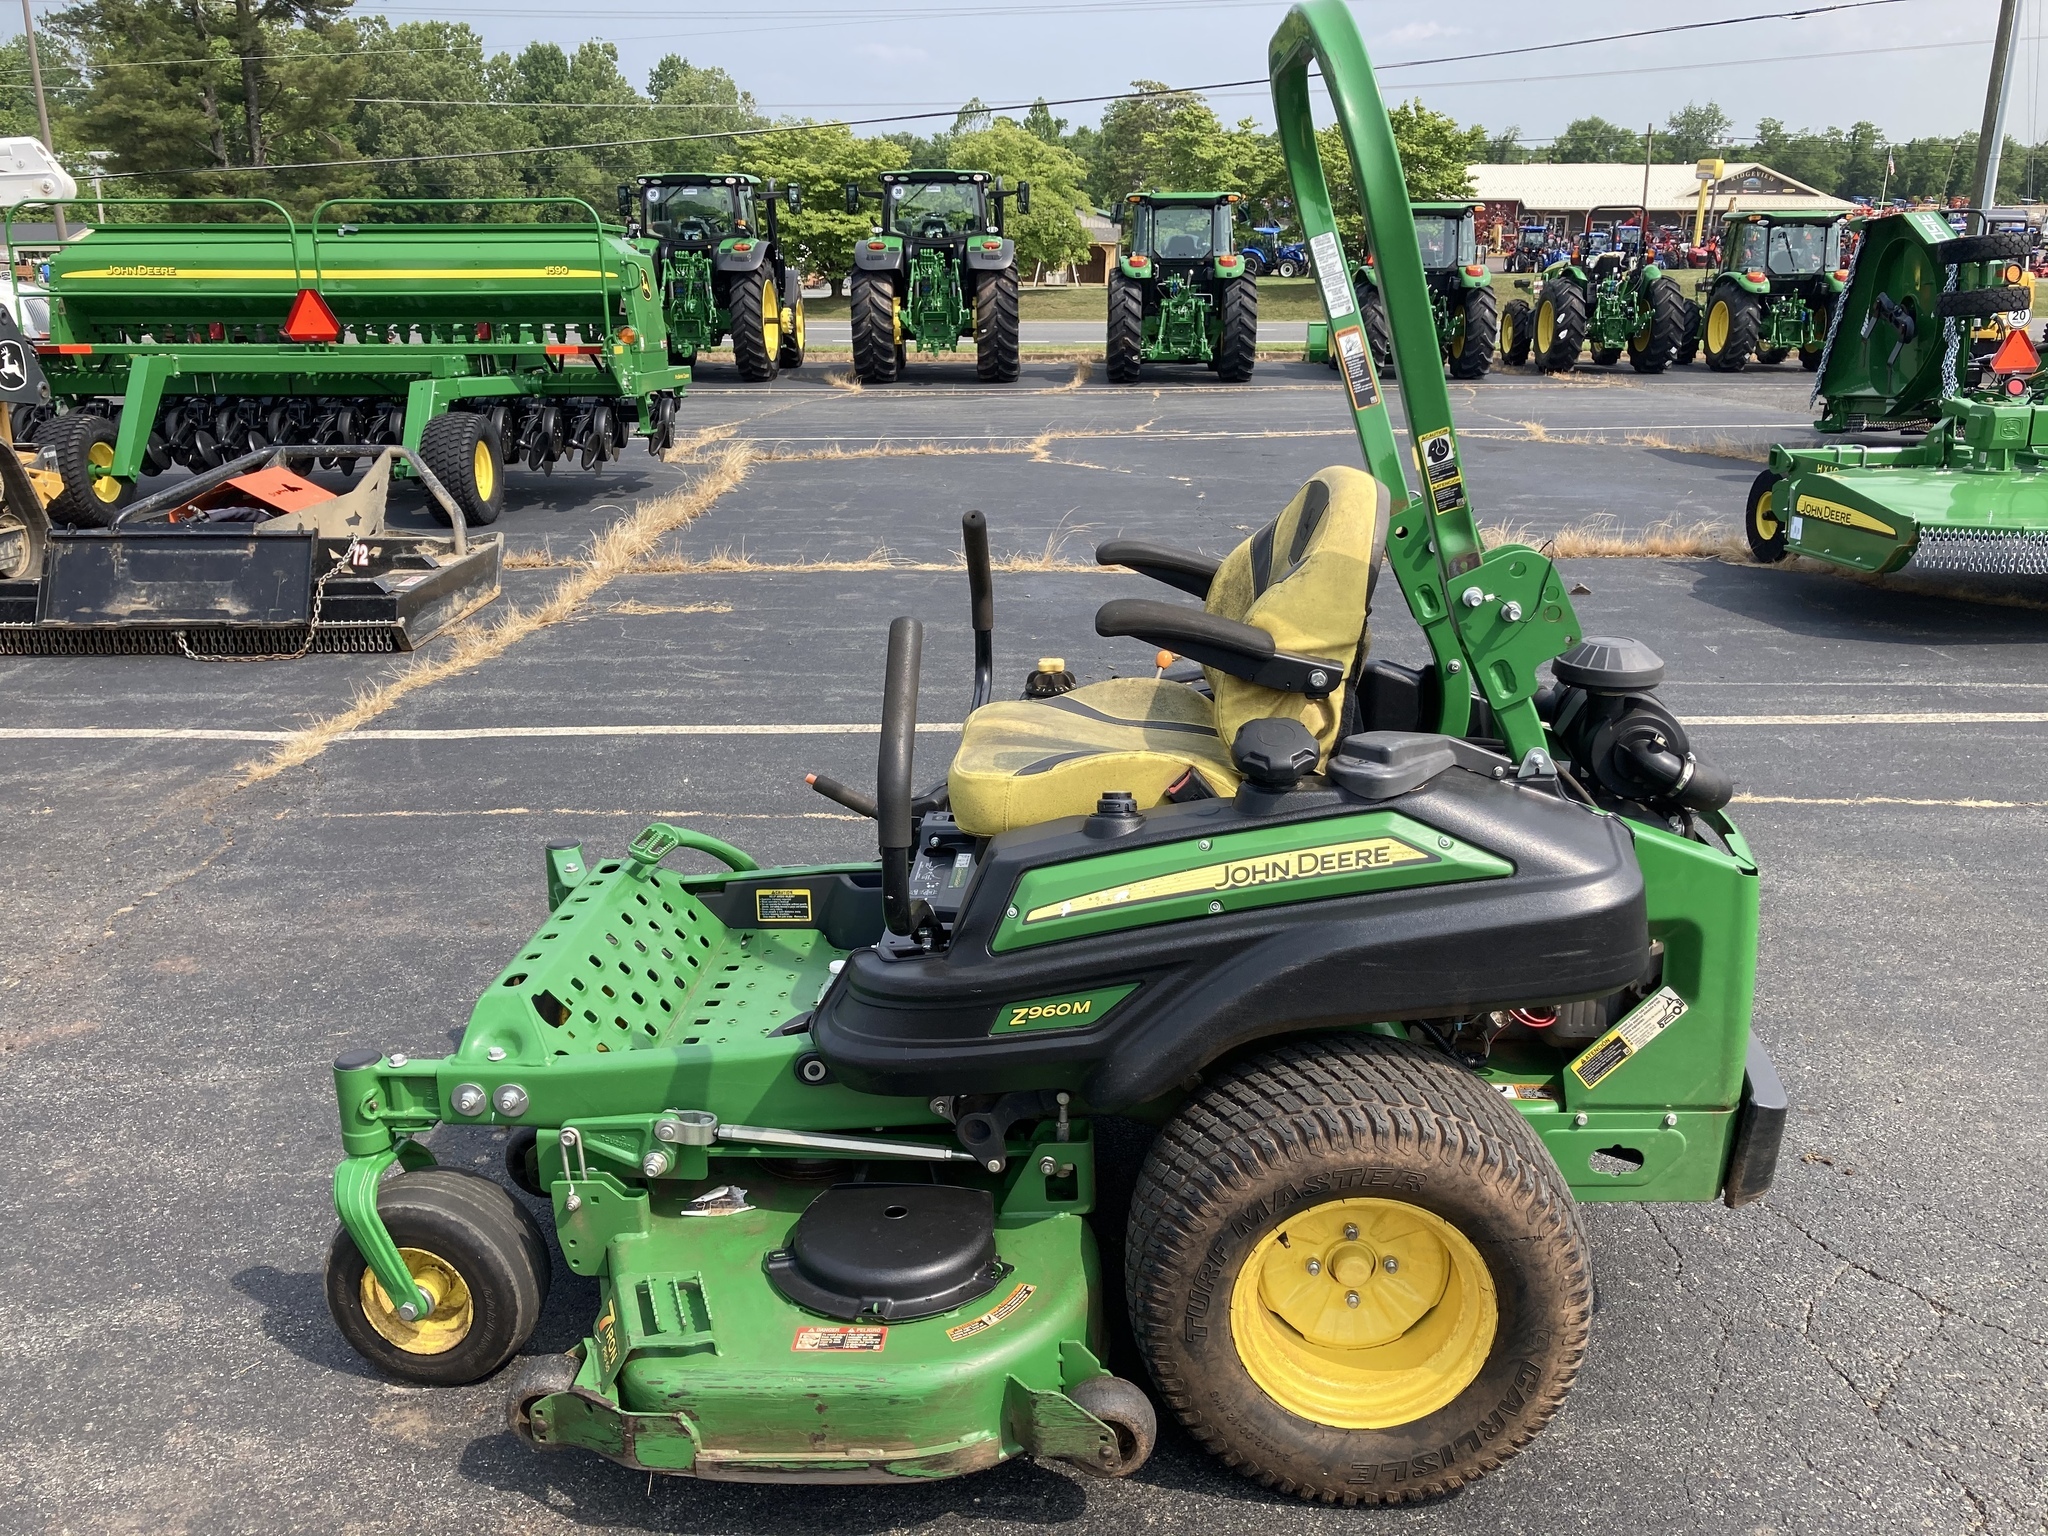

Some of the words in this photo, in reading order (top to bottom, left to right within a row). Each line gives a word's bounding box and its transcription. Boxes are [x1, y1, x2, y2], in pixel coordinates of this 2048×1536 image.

[1731, 170, 1775, 182] RIDGEVIEW
[107, 265, 138, 276] JOHN
[138, 265, 177, 276] DEERE
[544, 266, 569, 276] 1590
[2012, 310, 2026, 321] 20
[1800, 501, 1823, 517] JOHN
[1824, 505, 1852, 524] DEERE
[1214, 859, 1291, 889] JOHN
[1297, 845, 1391, 876] DEERE
[1009, 1000, 1092, 1026] Z960M
[1585, 1037, 1612, 1060] ATENCIÓN
[1186, 1235, 1231, 1343] TURF
[1231, 1166, 1429, 1241] MASTER
[1347, 1360, 1542, 1485] CARLISLE
